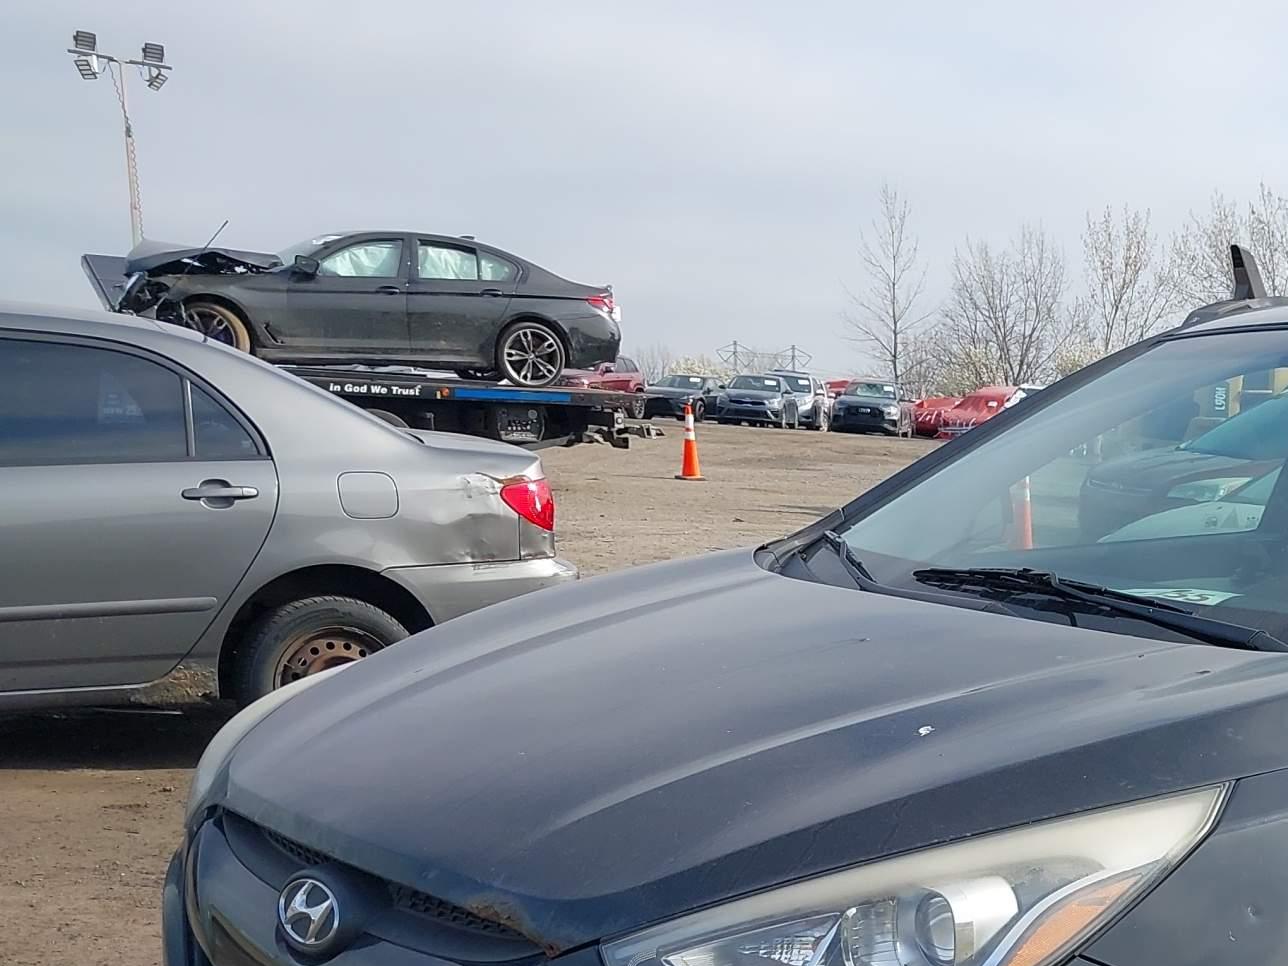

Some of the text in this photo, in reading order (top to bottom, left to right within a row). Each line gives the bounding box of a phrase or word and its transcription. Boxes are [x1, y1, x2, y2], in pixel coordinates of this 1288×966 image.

[344, 383, 367, 393] God
[370, 384, 388, 394] We
[391, 385, 421, 396] Trust
